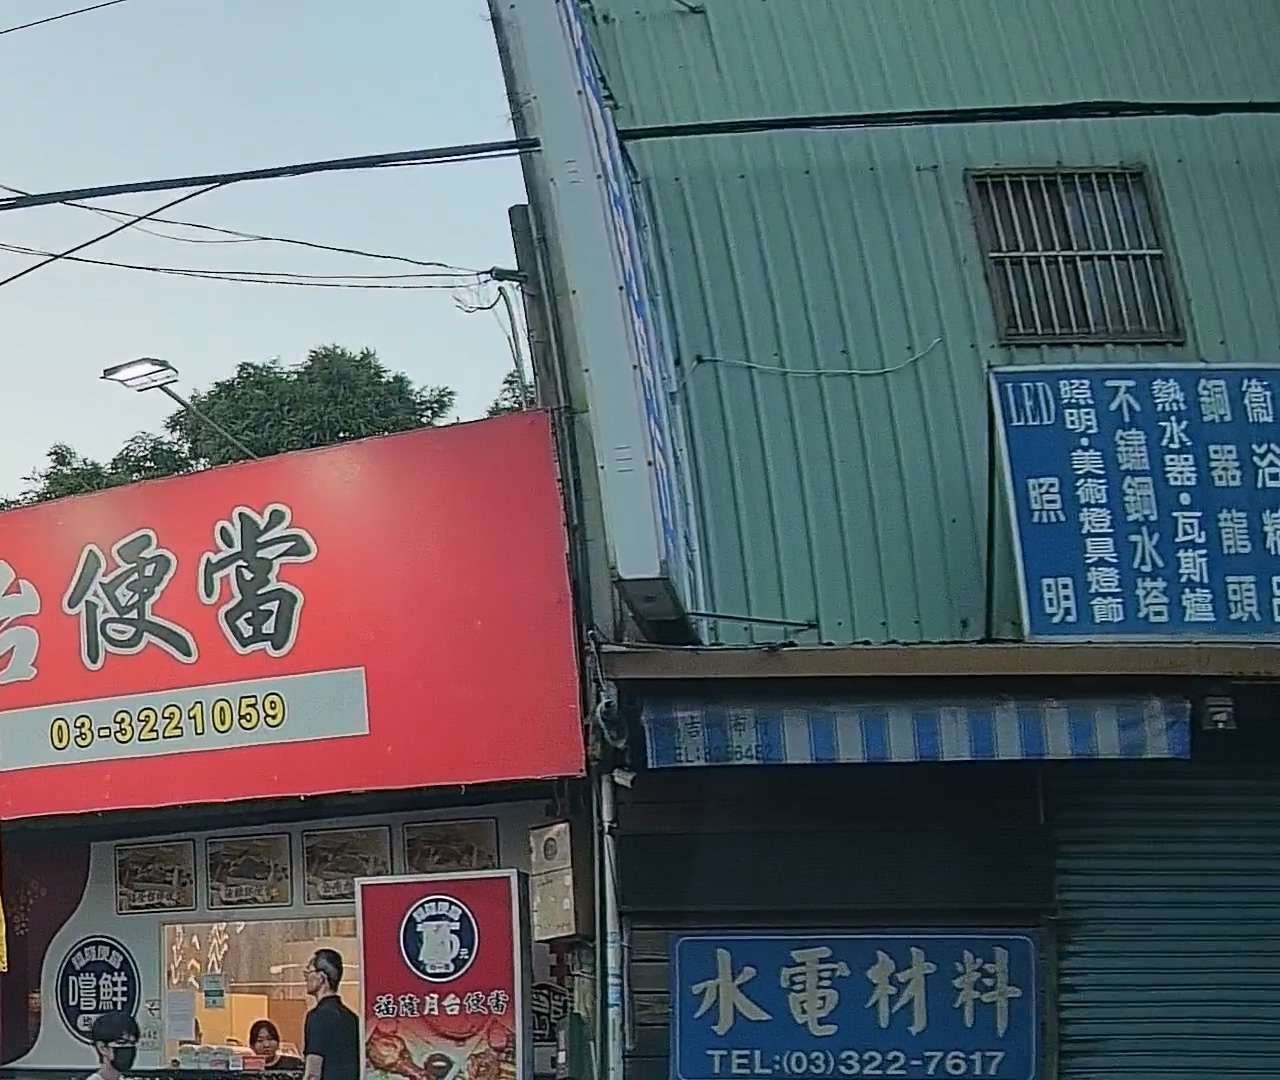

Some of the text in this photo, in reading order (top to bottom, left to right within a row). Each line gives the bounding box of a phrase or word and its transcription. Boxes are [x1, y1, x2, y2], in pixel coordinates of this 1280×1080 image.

[1005, 381, 1057, 426] LED
[1241, 378, 1280, 623] 衛浴精
[49, 691, 287, 750] 03-3221059
[68, 970, 128, 1011] 嚐鮮
[690, 945, 1023, 1039] 水電材料
